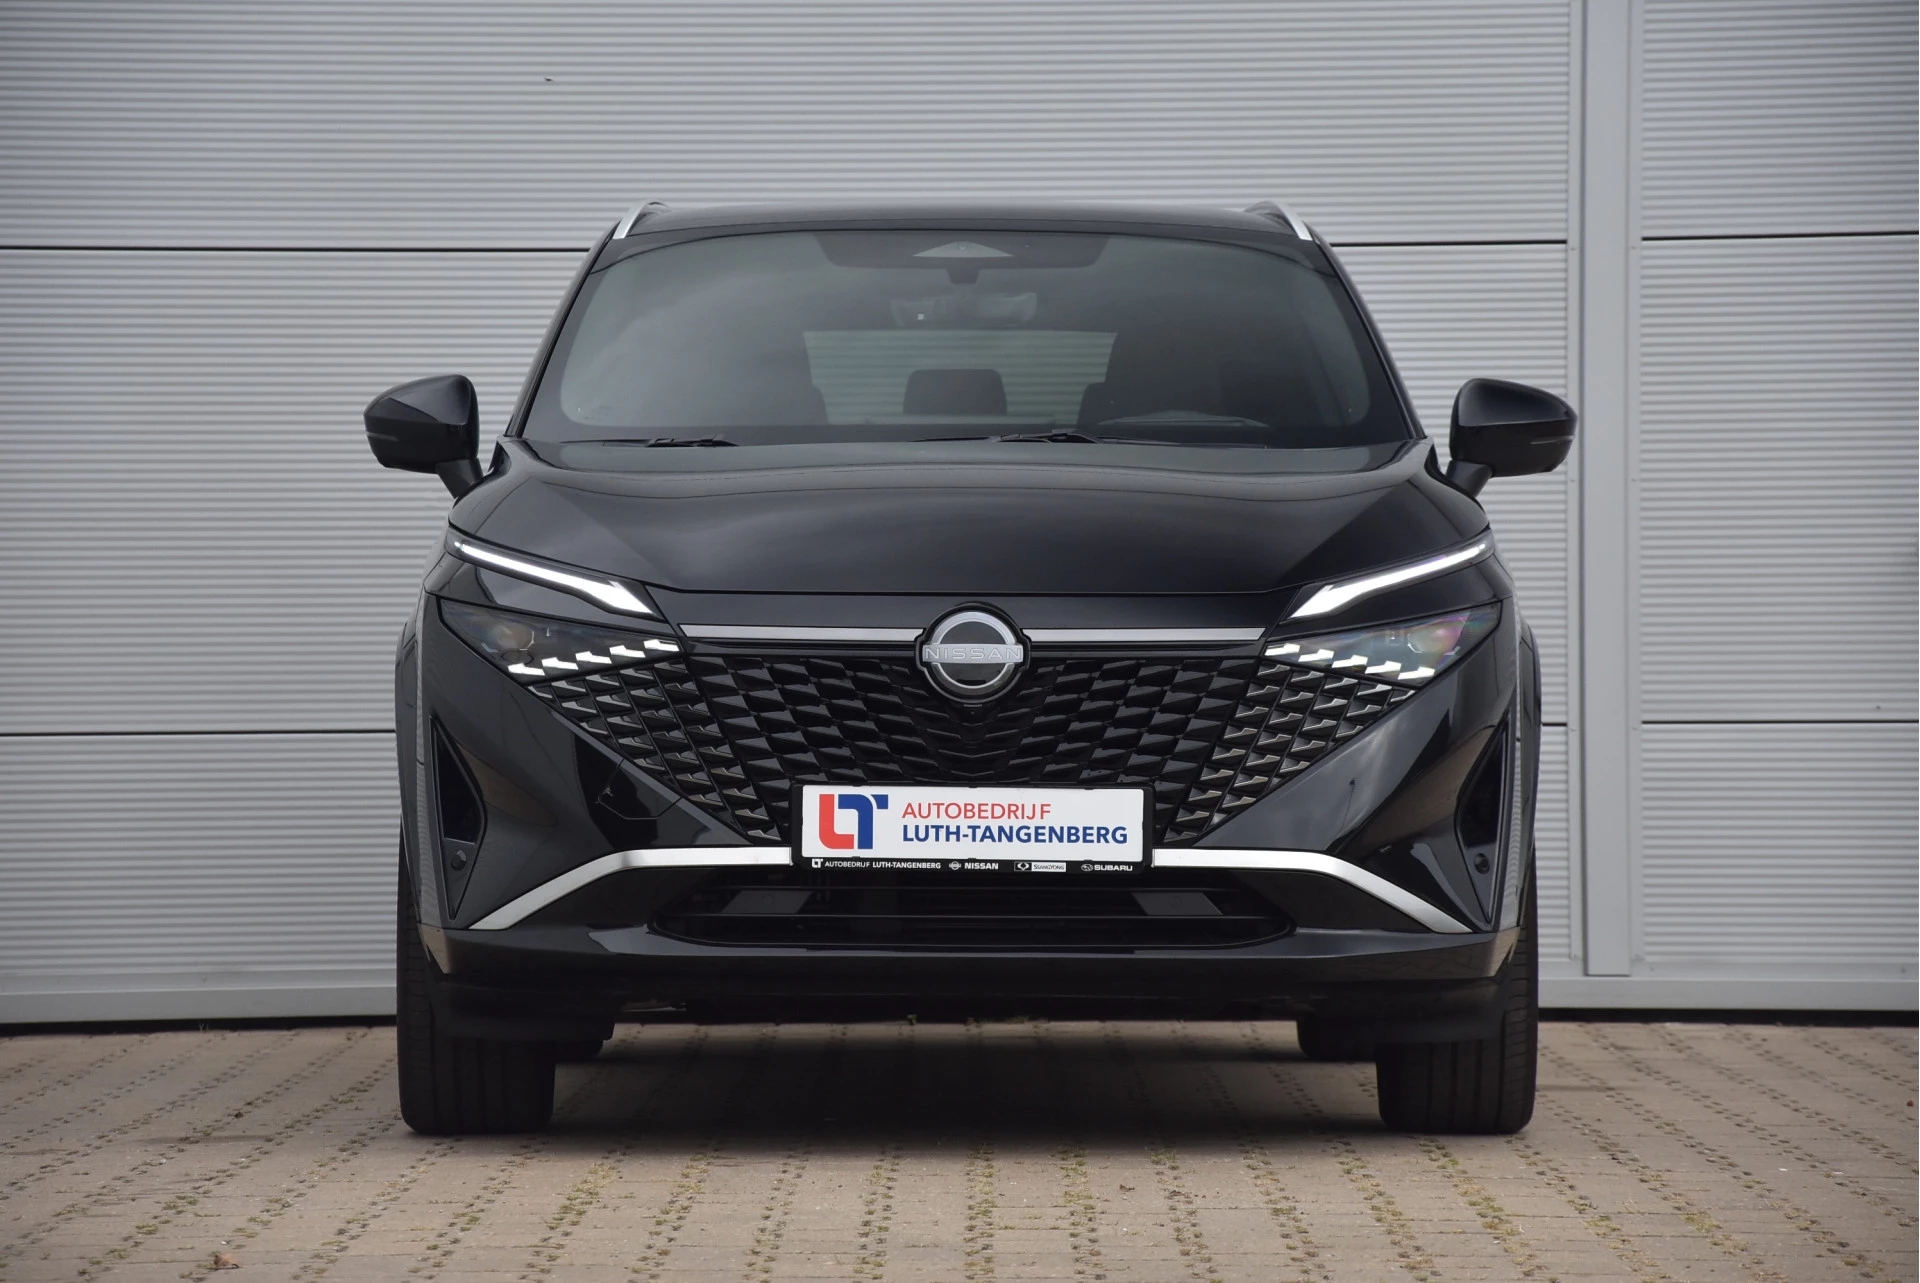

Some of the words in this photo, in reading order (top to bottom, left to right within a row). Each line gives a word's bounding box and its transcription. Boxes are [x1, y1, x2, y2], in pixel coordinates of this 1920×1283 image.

[925, 648, 1021, 660] NISSAN
[902, 802, 1052, 820] AUTOBEDRIJF
[902, 825, 1128, 844] LUTH-TANGENBERG
[872, 861, 941, 869] LUTH-TANGENBERG
[964, 862, 999, 870] NISSAN
